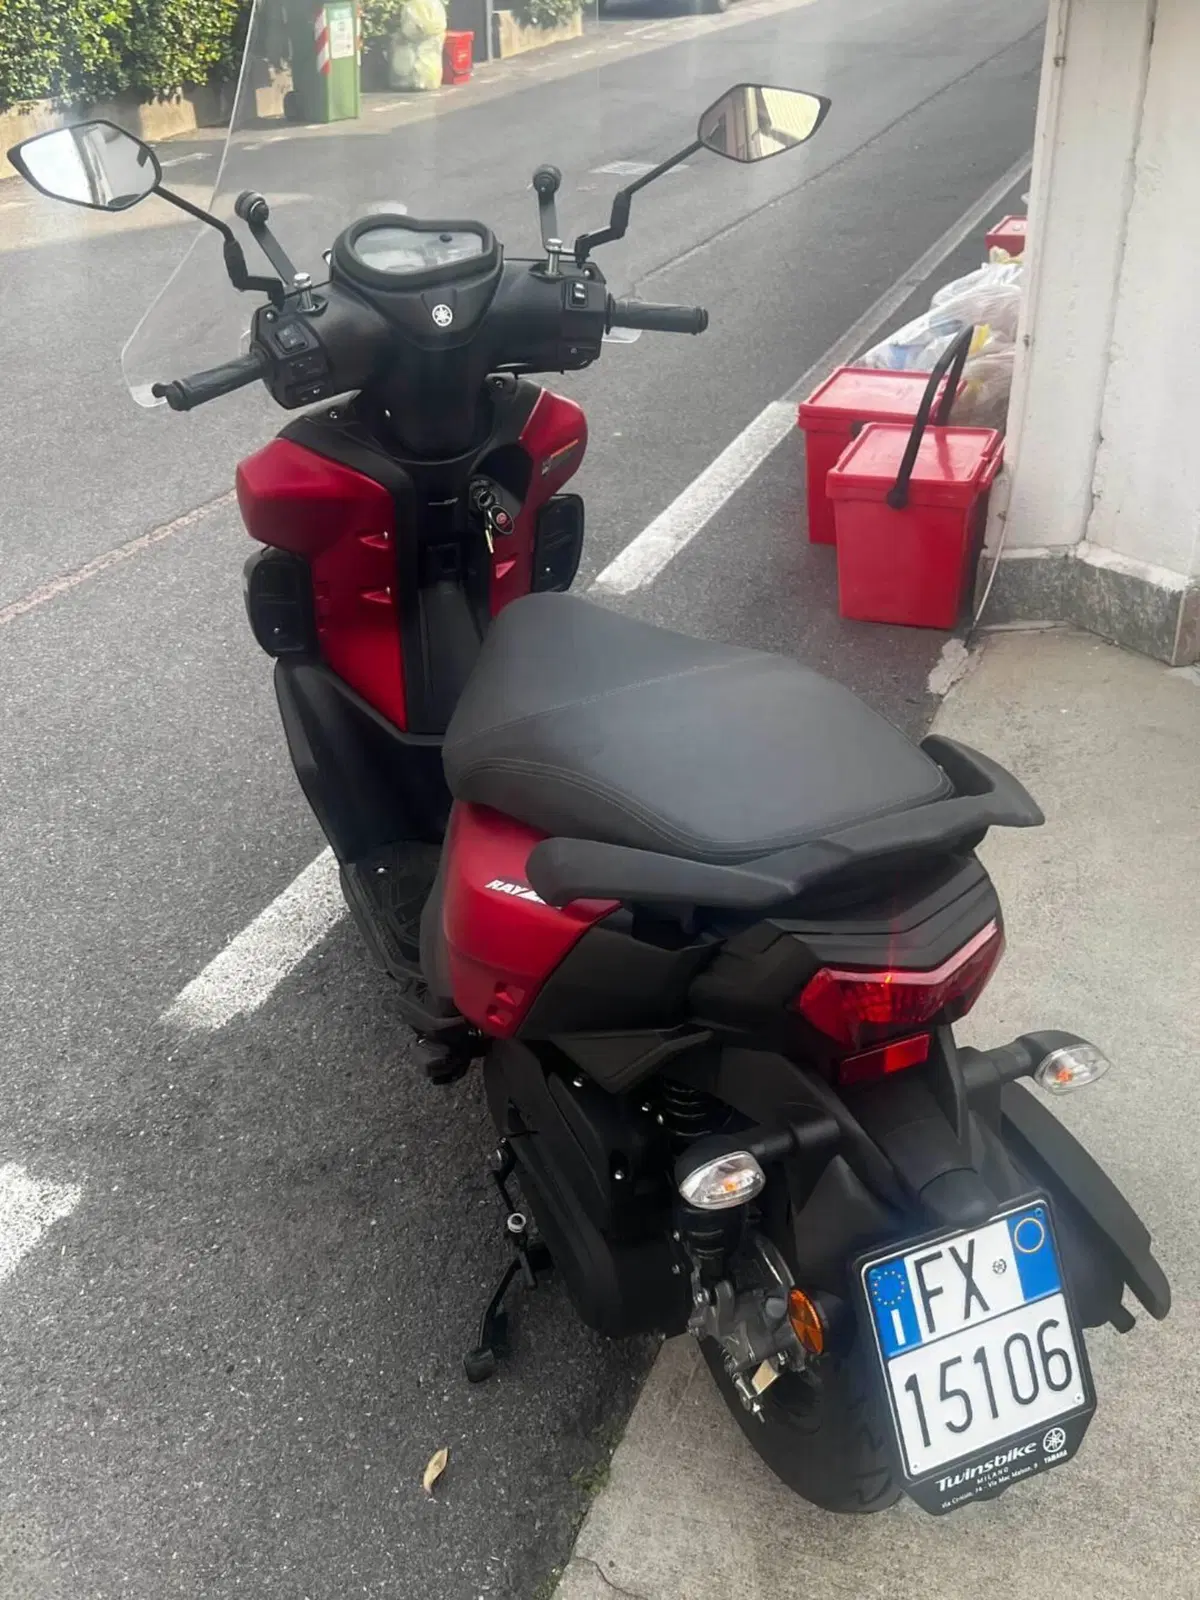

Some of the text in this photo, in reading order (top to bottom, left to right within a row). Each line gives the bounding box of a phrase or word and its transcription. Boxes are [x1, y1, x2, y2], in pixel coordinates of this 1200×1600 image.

[914, 1238, 990, 1334] FX
[904, 1318, 1073, 1448] 15106
[935, 1442, 1037, 1492] Twinsbike
[977, 1466, 1009, 1485] MILANO
